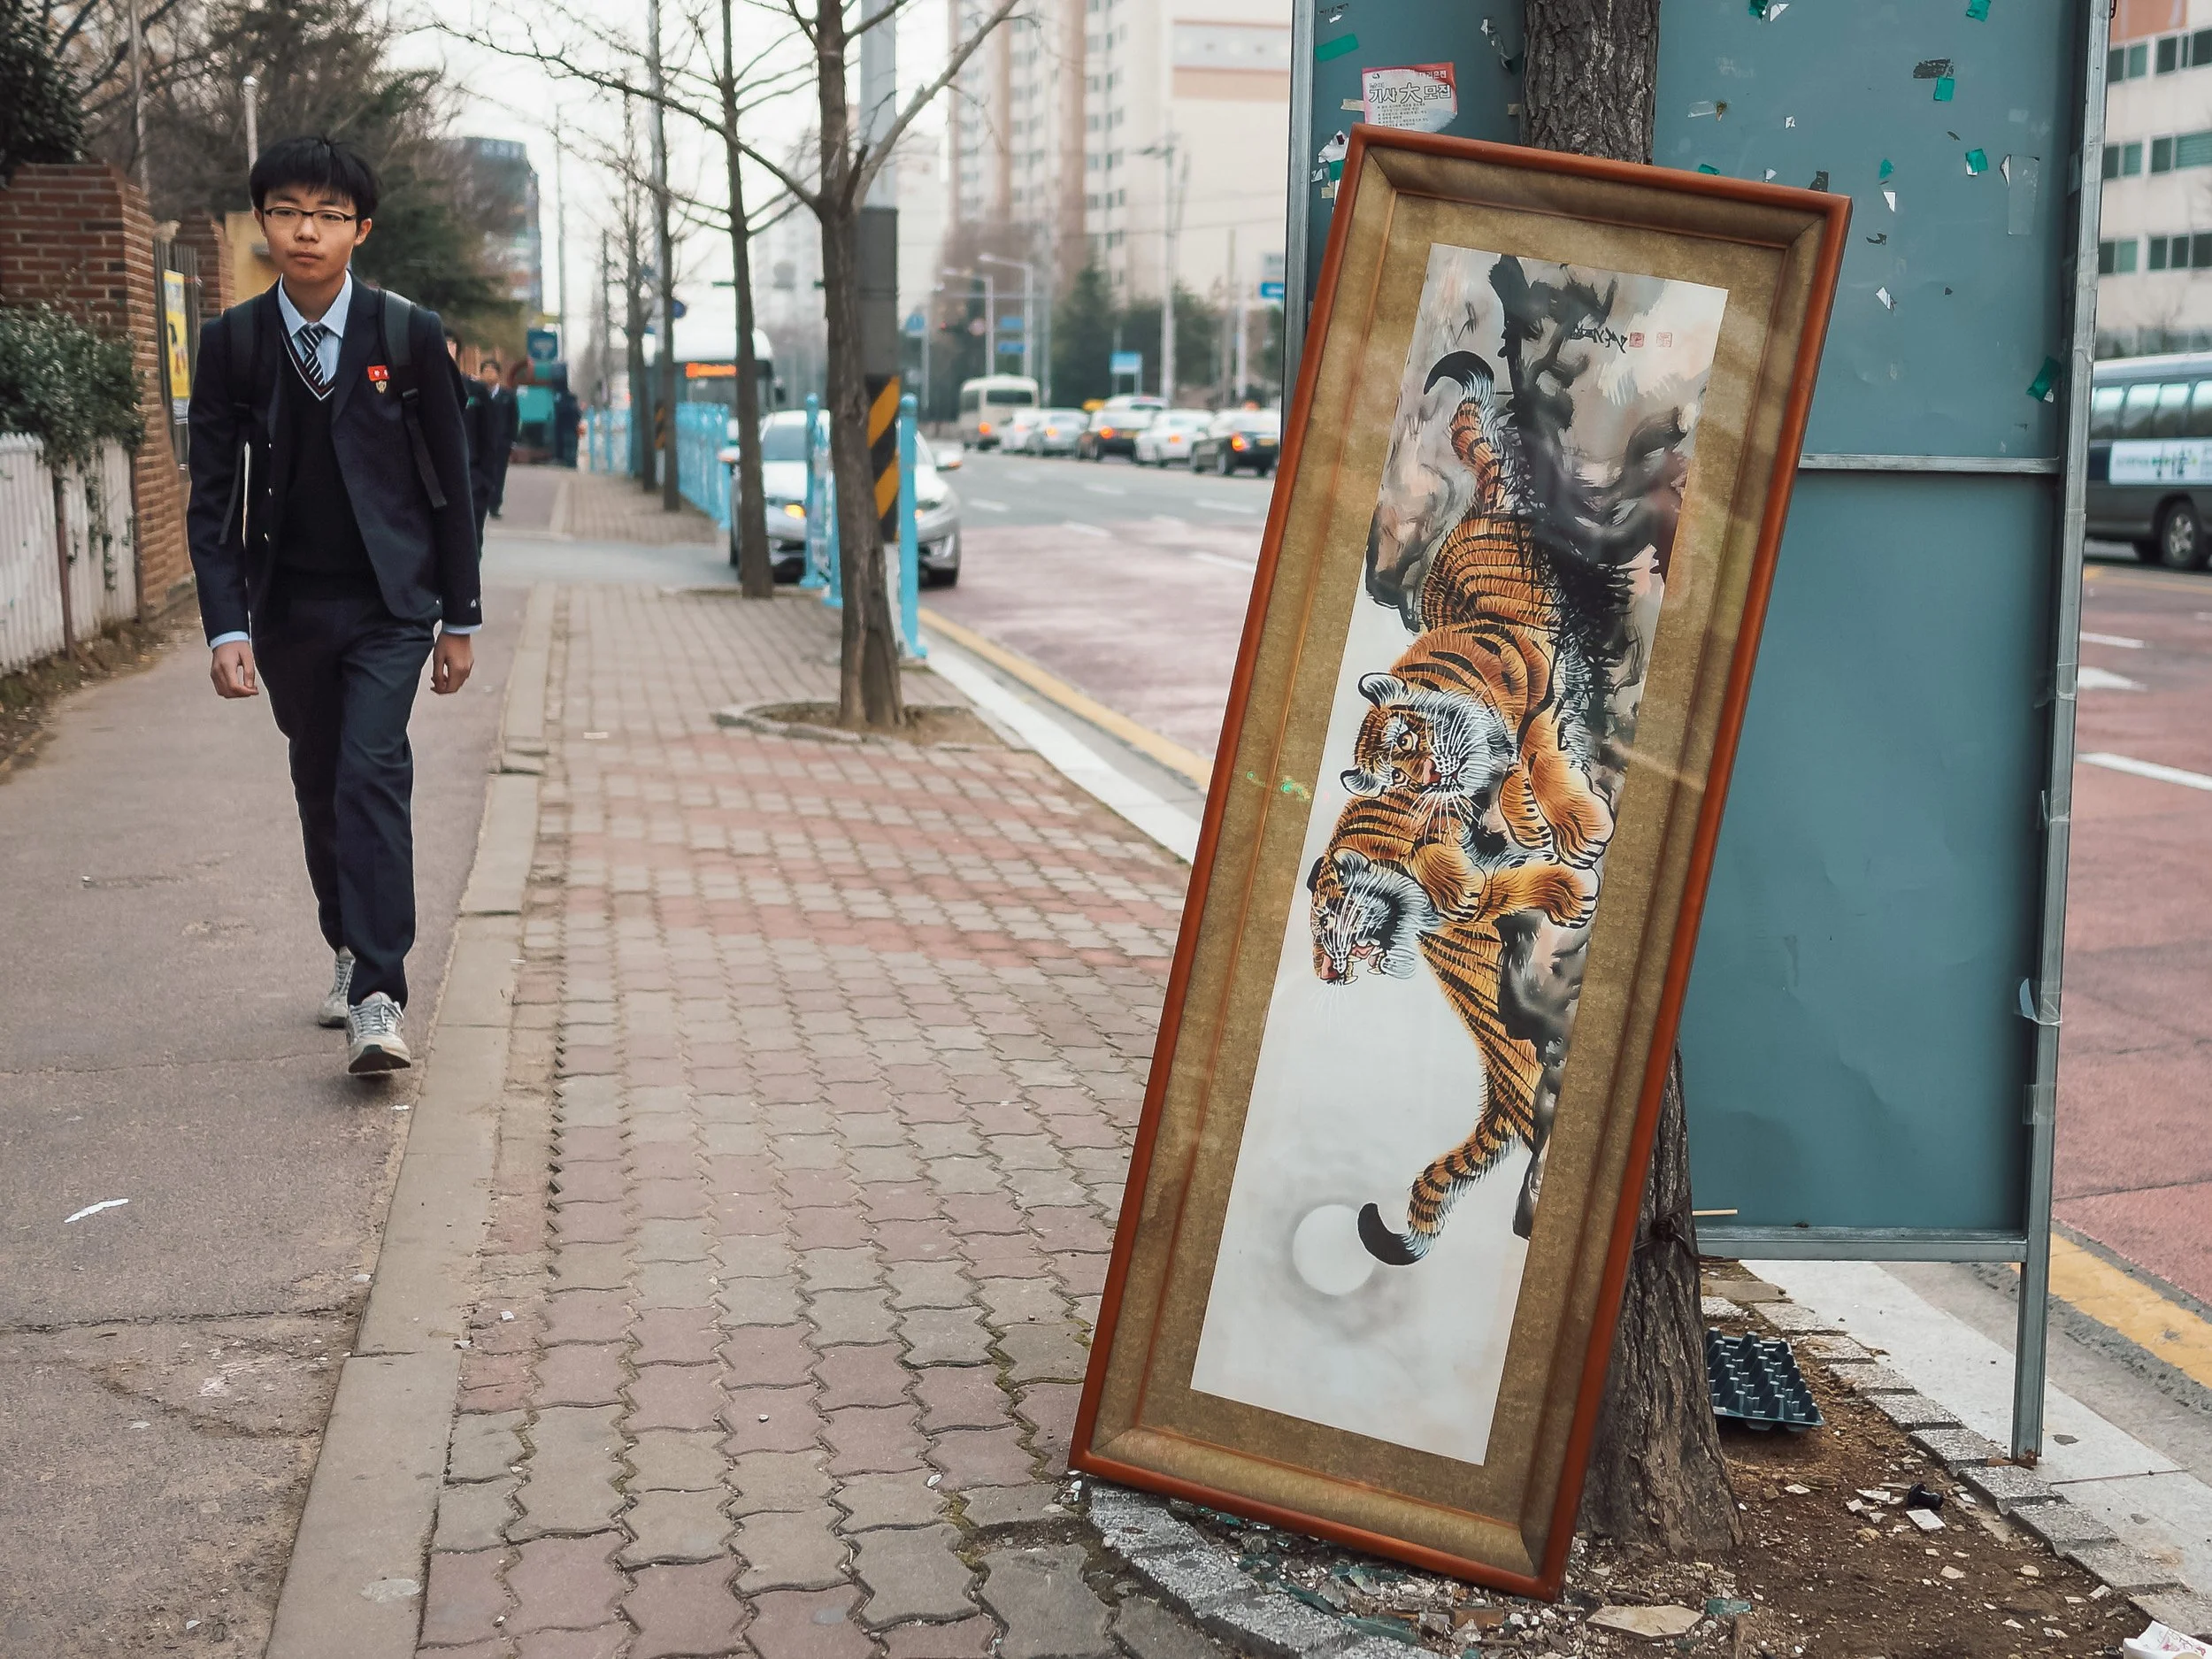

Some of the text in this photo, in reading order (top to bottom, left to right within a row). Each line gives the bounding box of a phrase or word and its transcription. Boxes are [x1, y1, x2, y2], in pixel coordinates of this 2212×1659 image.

[1370, 82, 1451, 104] 기사 大 모집
